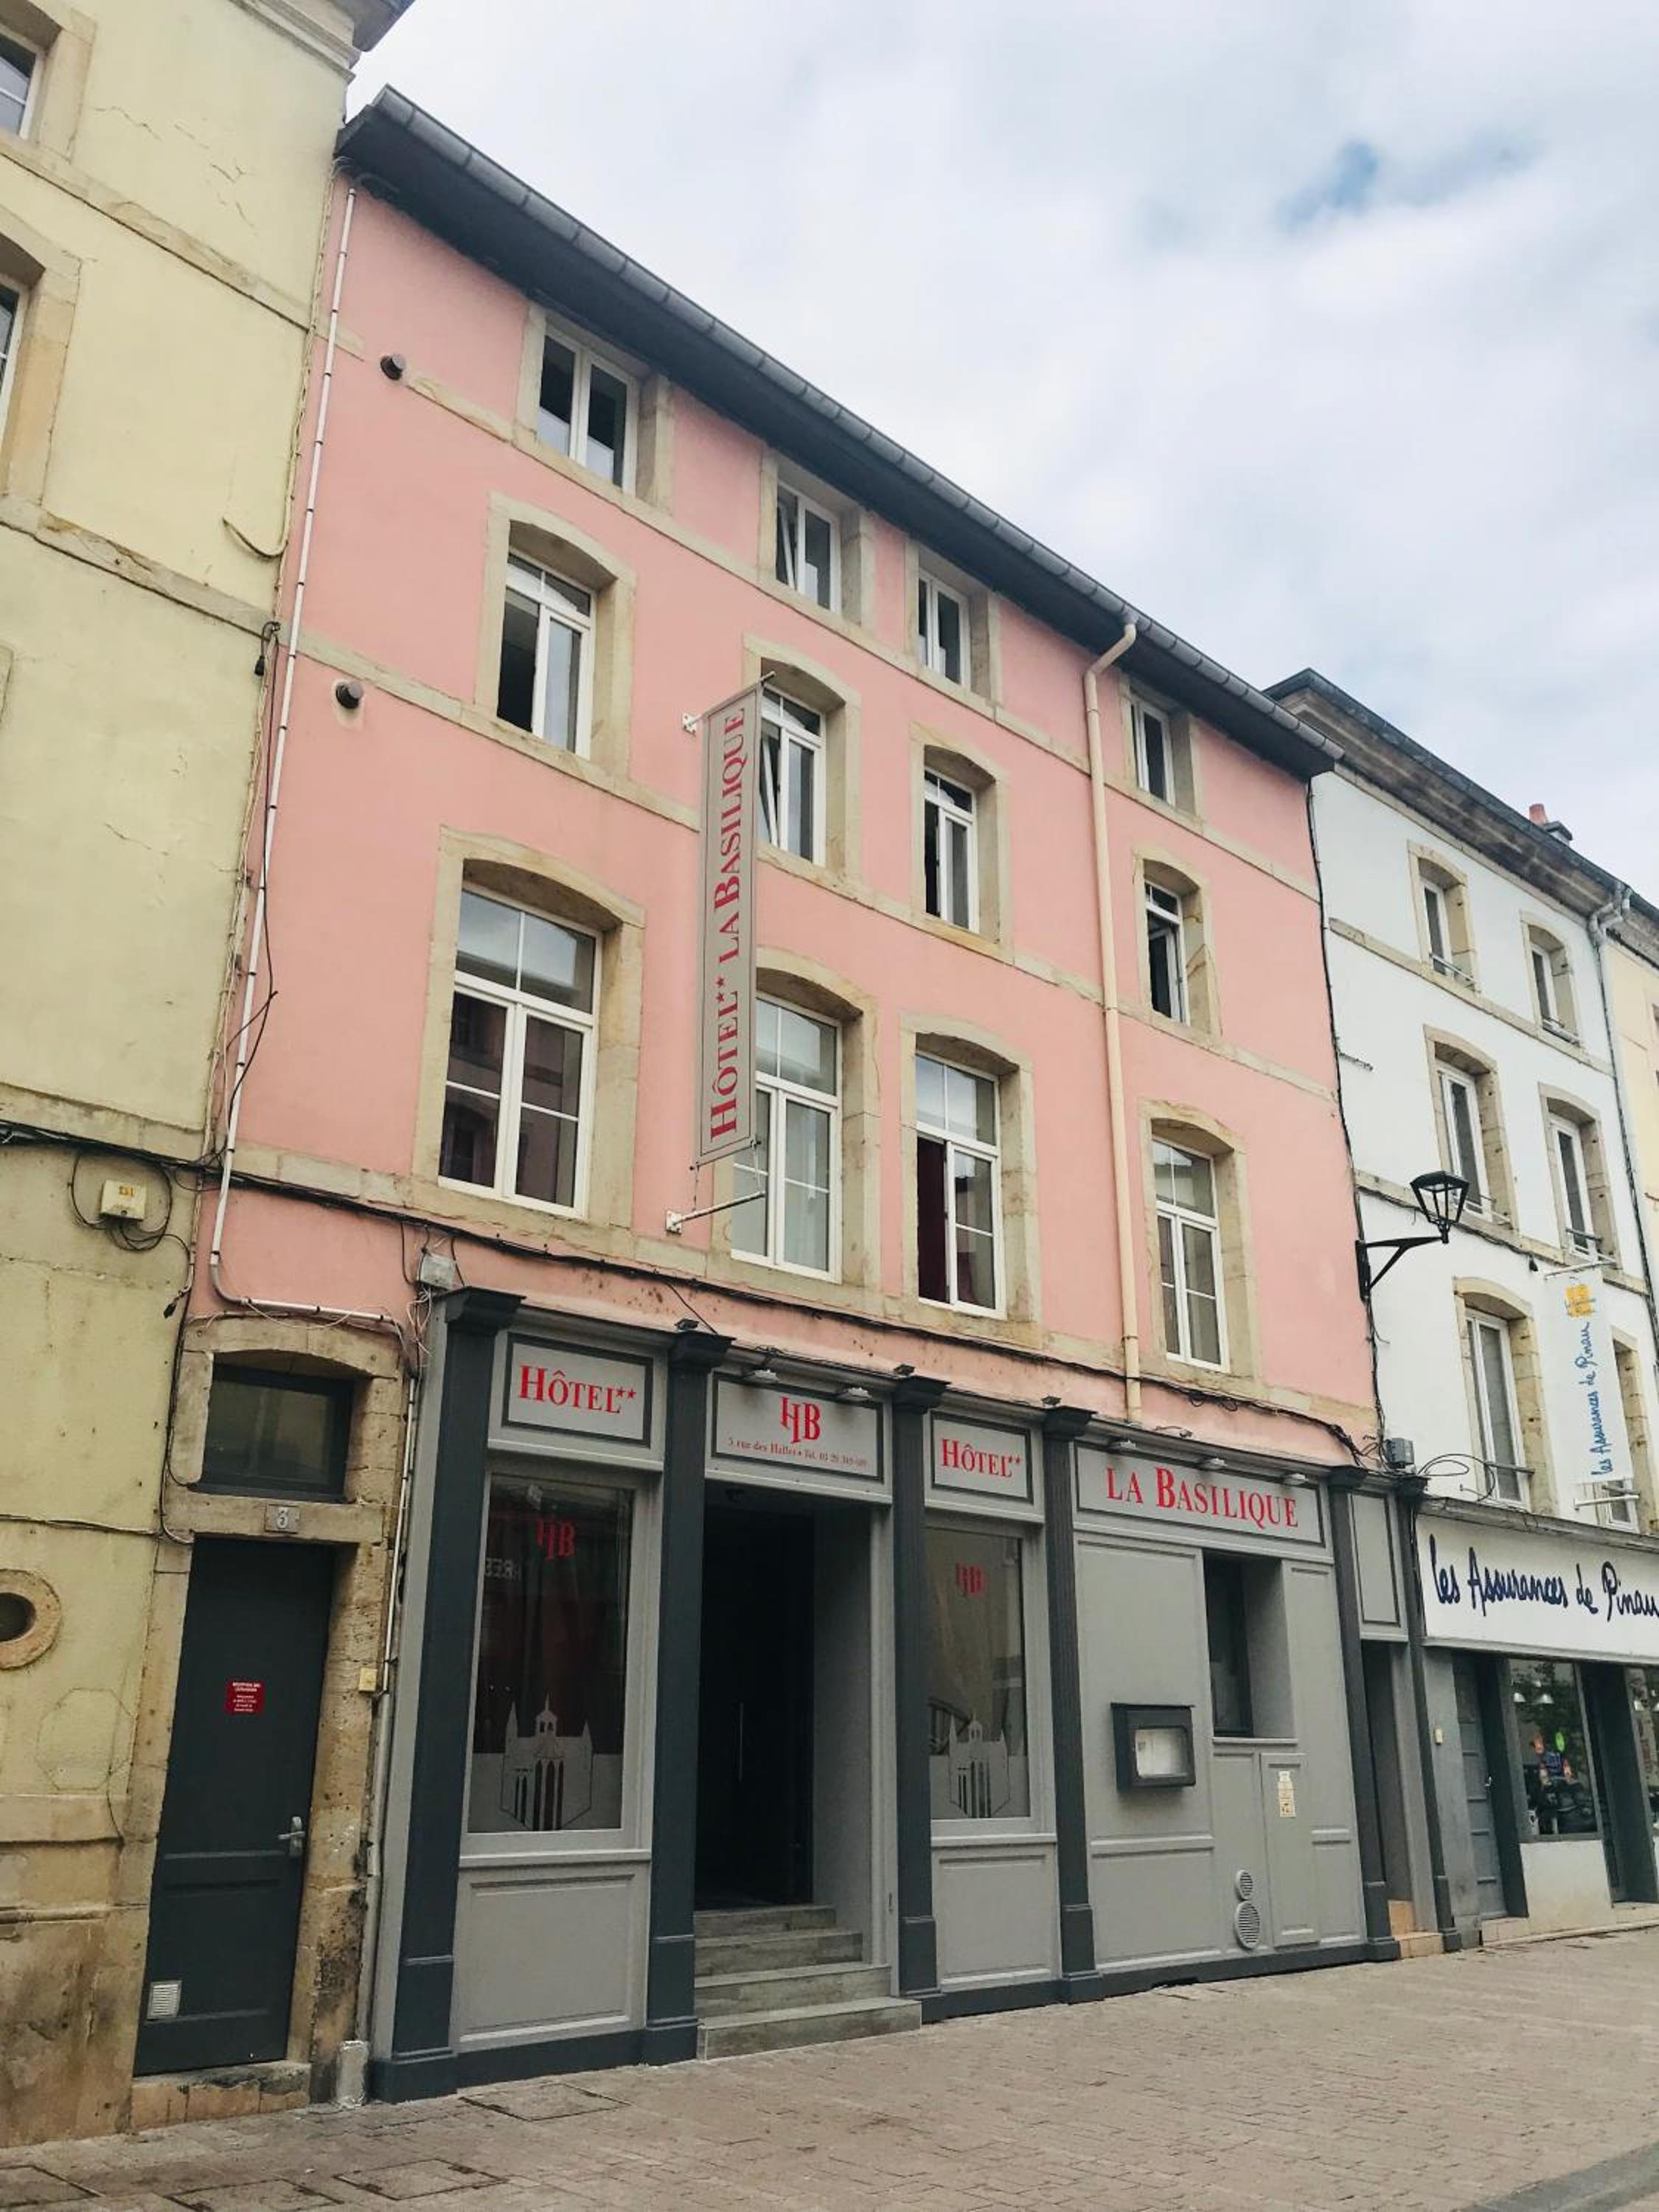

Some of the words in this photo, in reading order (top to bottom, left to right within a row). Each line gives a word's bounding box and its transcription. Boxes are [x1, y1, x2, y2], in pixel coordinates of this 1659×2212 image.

[714, 708, 747, 909] BASILIQUE
[718, 911, 740, 964] LA
[1579, 1370, 1596, 1386] de
[753, 1441, 768, 1452] des
[1587, 1391, 1613, 1455] Assurances
[1107, 1467, 1144, 1504] LA
[1155, 1467, 1300, 1529] BASILIQUE
[1467, 1546, 1568, 1617] Assurances
[1576, 1562, 1599, 1614] de
